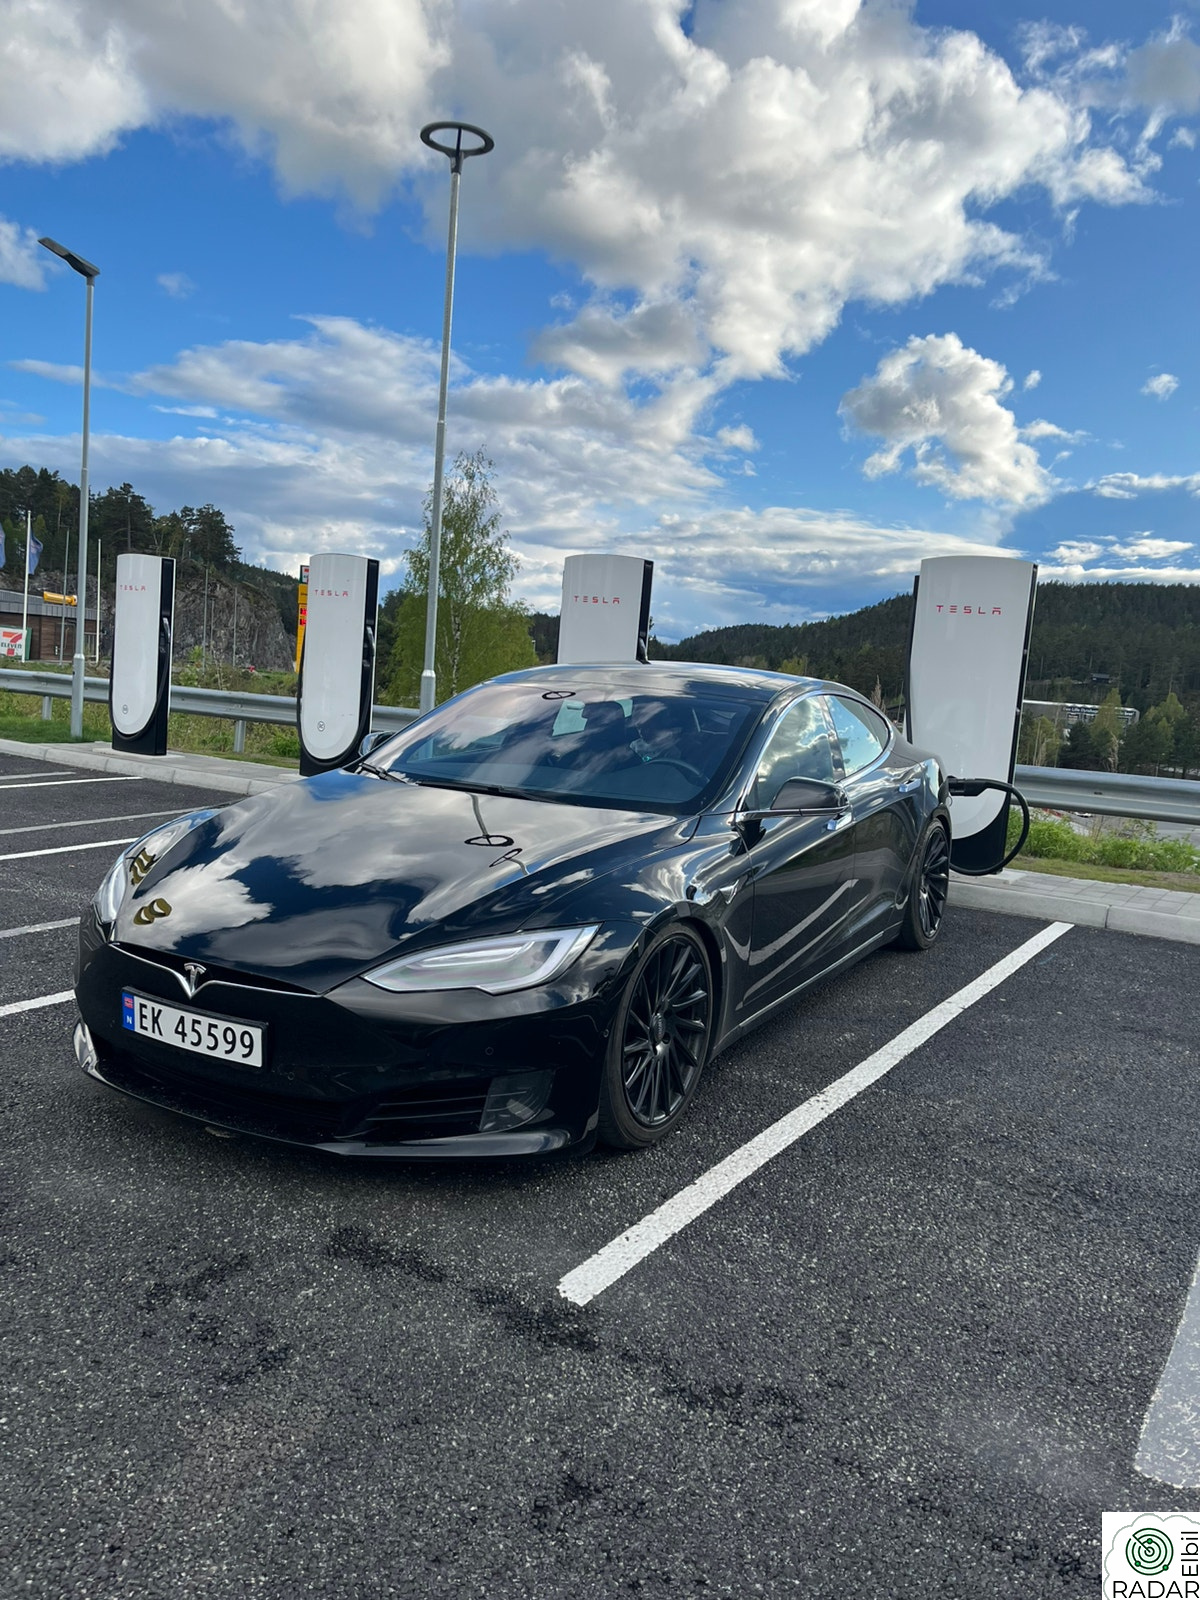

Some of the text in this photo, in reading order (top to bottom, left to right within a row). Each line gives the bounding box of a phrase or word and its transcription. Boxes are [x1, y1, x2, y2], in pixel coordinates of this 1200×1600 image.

[314, 589, 349, 597] TESLA
[573, 595, 620, 605] TESLA
[936, 605, 1002, 615] TESLA
[2, 631, 23, 656] 7
[126, 1015, 133, 1025] N
[139, 1002, 255, 1059] EK 45599
